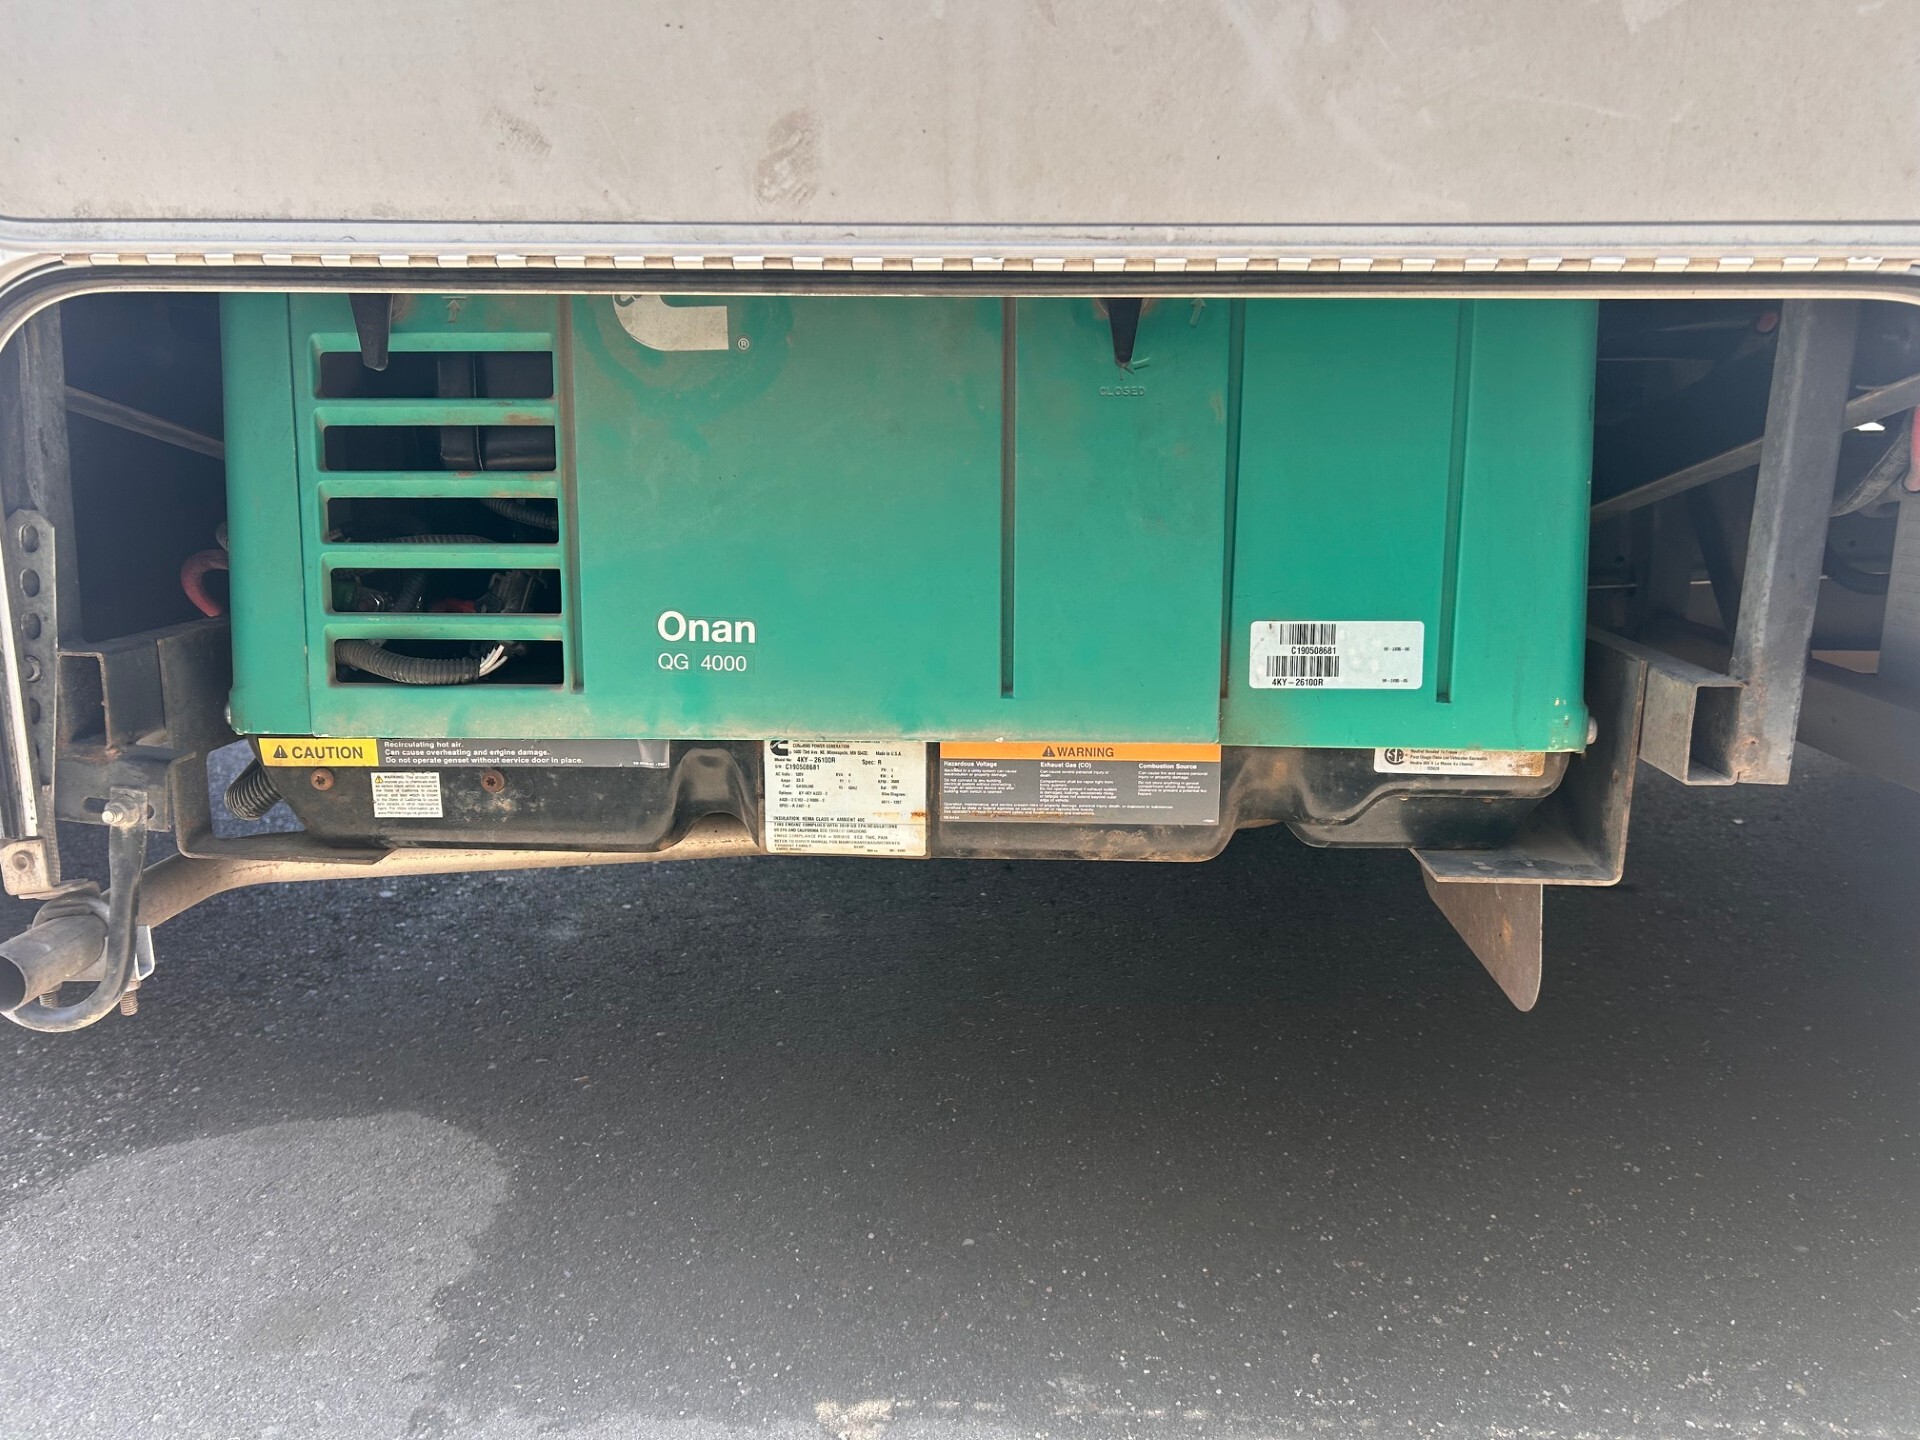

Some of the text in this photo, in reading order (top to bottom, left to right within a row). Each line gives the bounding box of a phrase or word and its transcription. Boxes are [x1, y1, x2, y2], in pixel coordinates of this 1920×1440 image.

[1098, 385, 1146, 397] CLOSED
[657, 610, 757, 644] Onan
[1291, 646, 1336, 655] C190508681
[657, 653, 747, 672] QG 4000
[292, 746, 364, 759] CAUTION
[384, 749, 550, 757] Can cause overheating and engine damage.
[1057, 747, 1114, 758] WARNING
[386, 757, 584, 765] Do not operate genset without service door in place.
[1078, 762, 1092, 770] (CO)
[785, 763, 820, 771] C190508681
